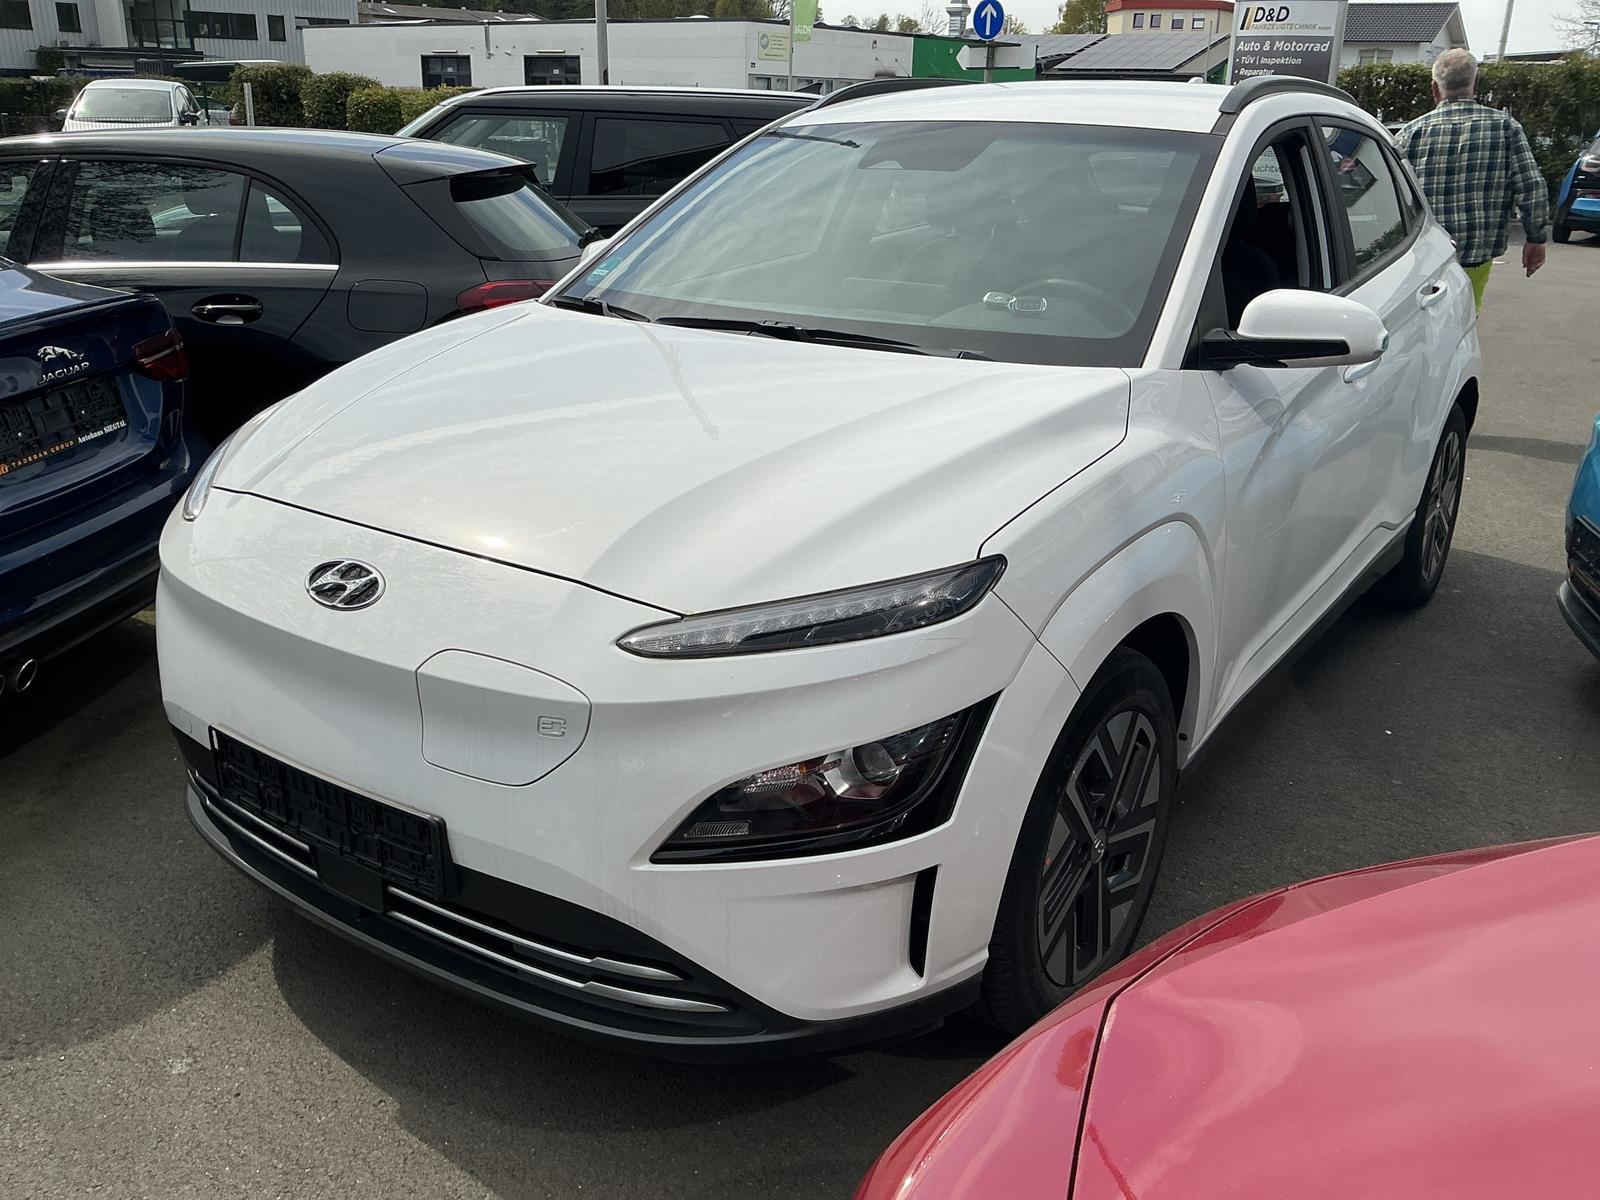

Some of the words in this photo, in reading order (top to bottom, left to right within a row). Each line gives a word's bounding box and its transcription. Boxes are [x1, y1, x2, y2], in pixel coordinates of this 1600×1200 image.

[1254, 6, 1290, 22] D&D
[1251, 23, 1318, 31] FAHRZEUGTECHNIK
[1237, 41, 1261, 52] Auto
[1263, 41, 1271, 51] &
[1273, 41, 1330, 52] Motorrad
[1241, 55, 1256, 65] TÜV
[1260, 56, 1302, 66] Inspektion
[1239, 68, 1275, 76] Reparatur
[38, 362, 90, 384] JAGUAR
[50, 440, 74, 454] GROUP
